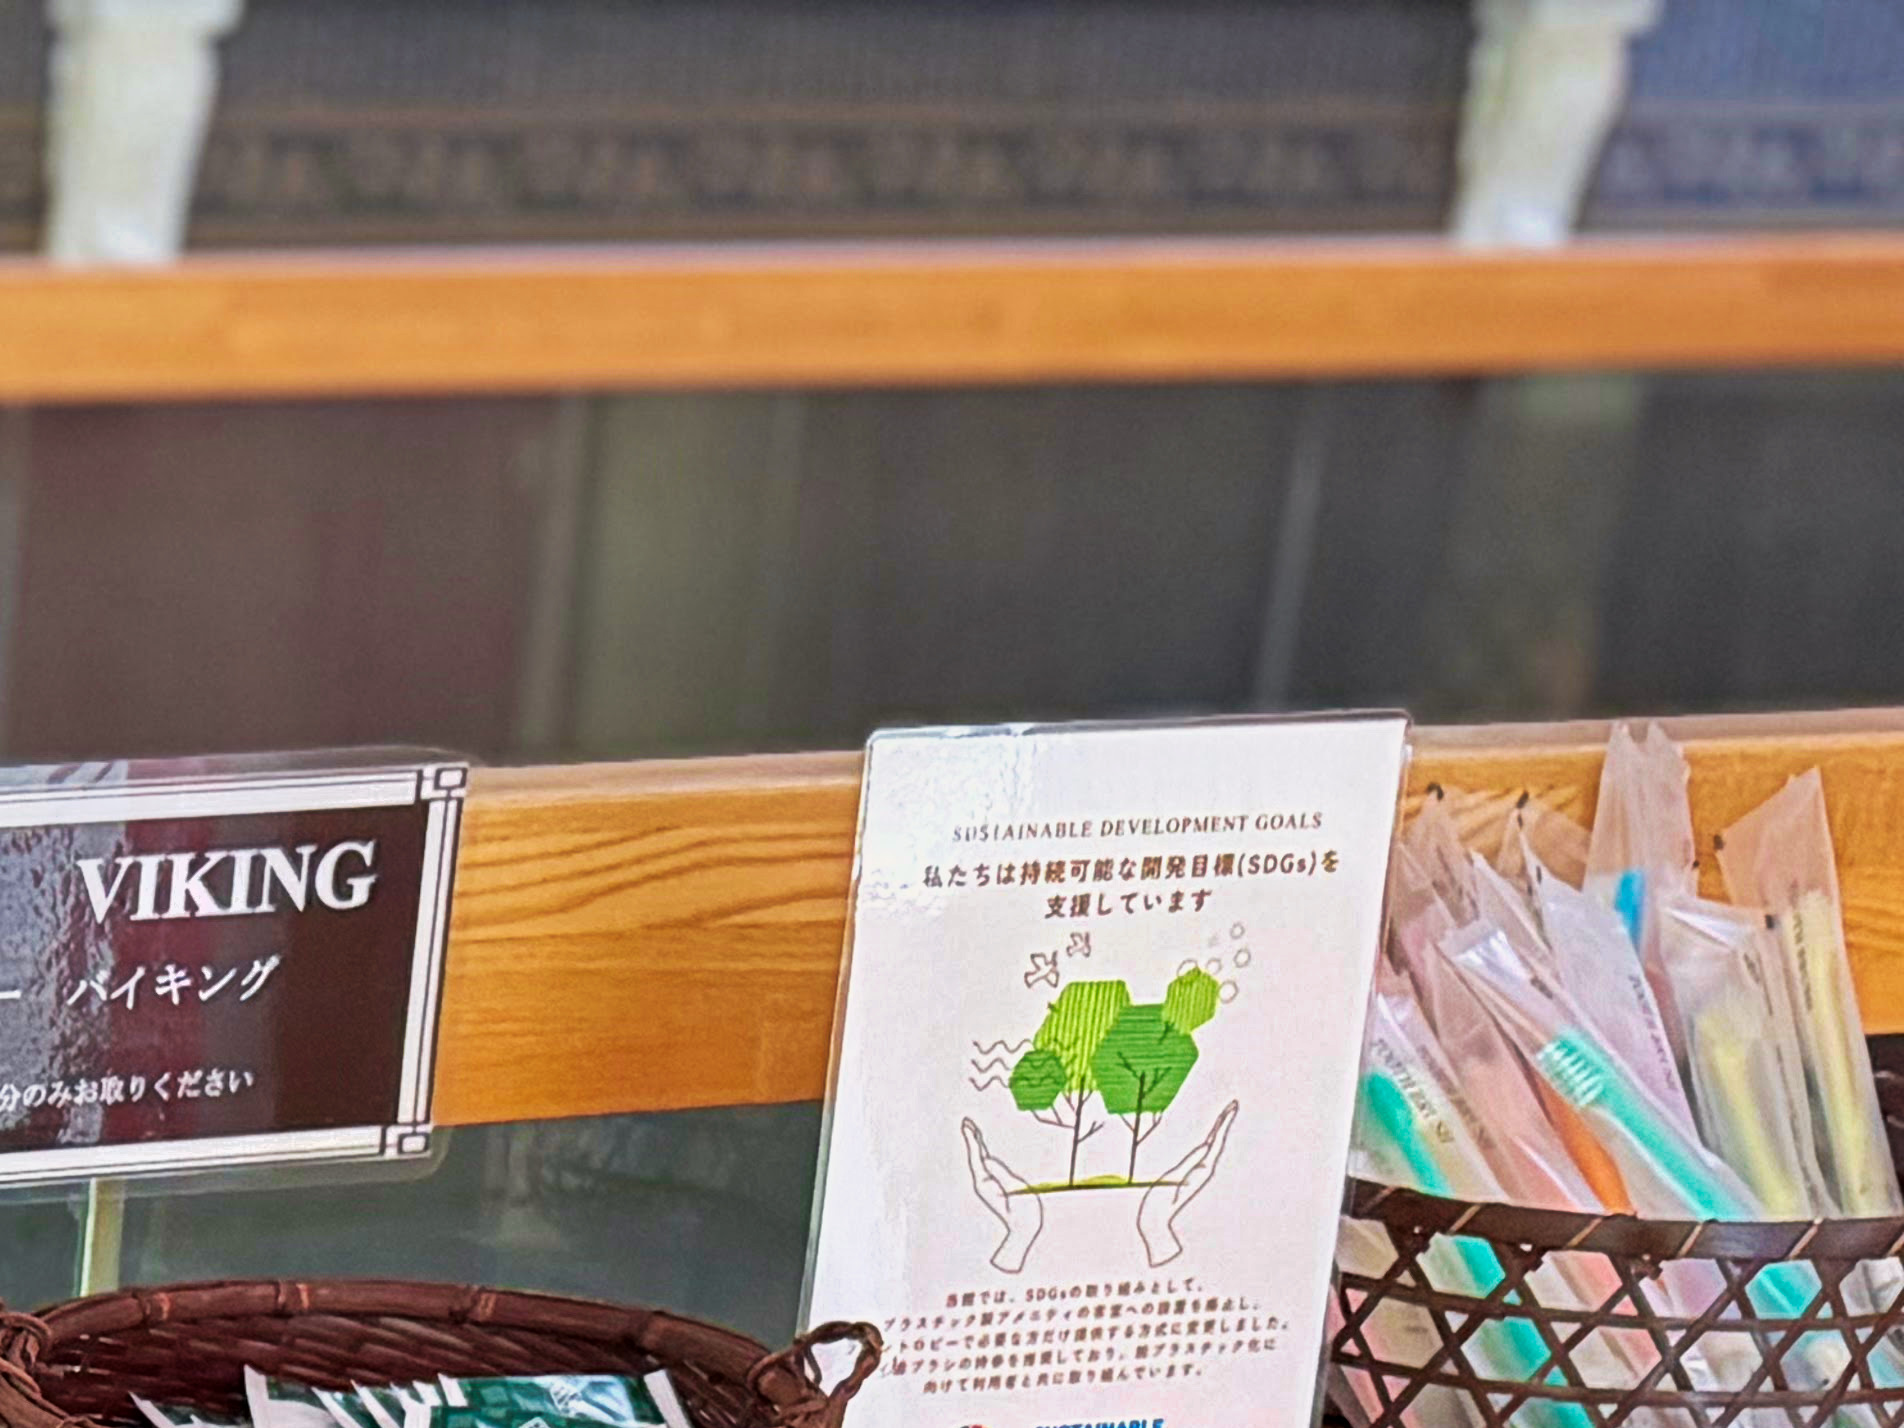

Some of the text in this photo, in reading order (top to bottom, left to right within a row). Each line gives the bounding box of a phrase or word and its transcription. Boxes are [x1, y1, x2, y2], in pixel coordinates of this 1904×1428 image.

[1100, 815, 1249, 837] DEVELOPMENT
[1254, 812, 1323, 832] GOALS
[76, 839, 378, 924] VIKING
[1044, 888, 1213, 920] 支援しています
[65, 955, 282, 1009] バイキング
